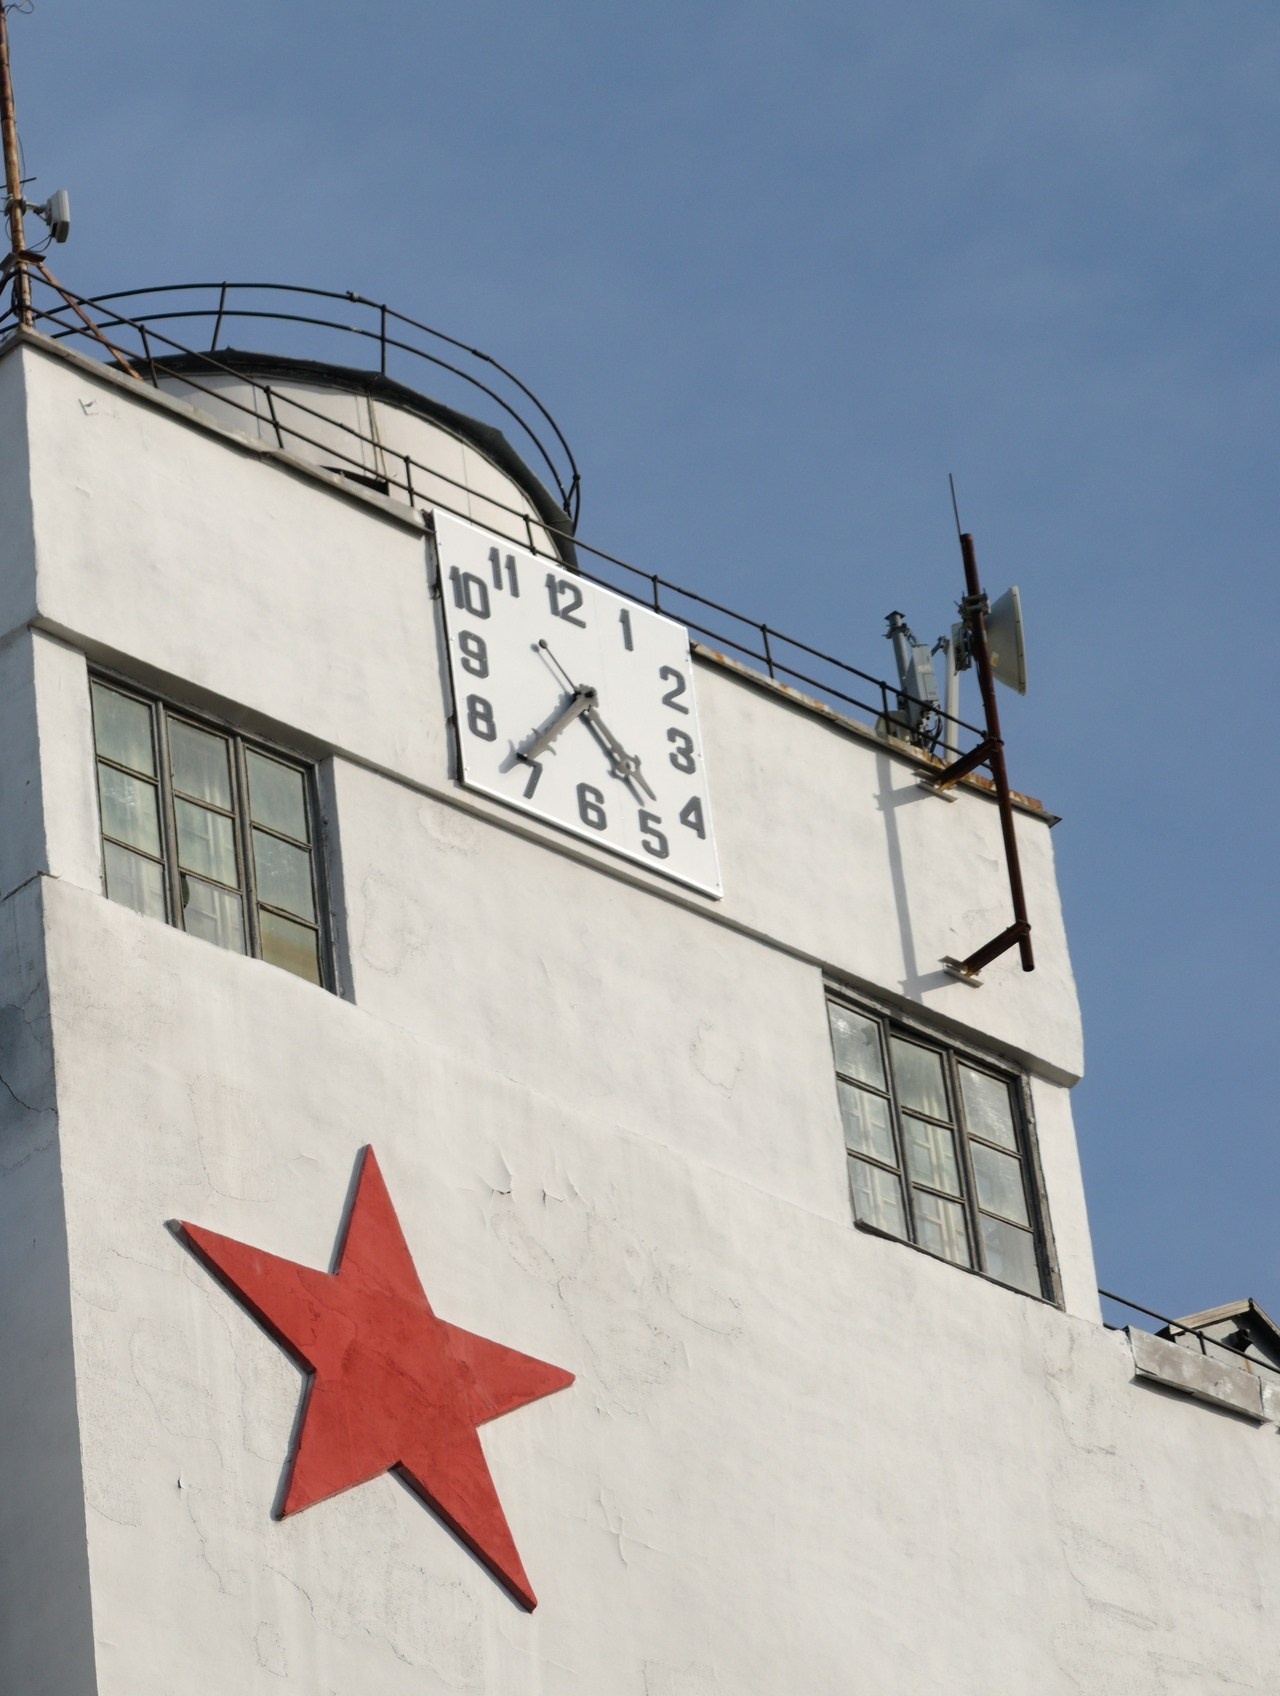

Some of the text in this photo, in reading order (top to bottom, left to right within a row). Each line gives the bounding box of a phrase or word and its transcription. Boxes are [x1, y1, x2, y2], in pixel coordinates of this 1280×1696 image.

[449, 566, 491, 619] 10
[488, 547, 519, 598] 11
[546, 574, 586, 628] 12
[619, 609, 633, 651] 1
[458, 630, 489, 679] 9
[660, 666, 689, 714] 2
[467, 694, 497, 742] 8
[667, 727, 696, 774] 3
[517, 753, 543, 799] 7
[576, 783, 607, 830] 6
[679, 796, 706, 839] 4
[638, 809, 669, 859] 5
